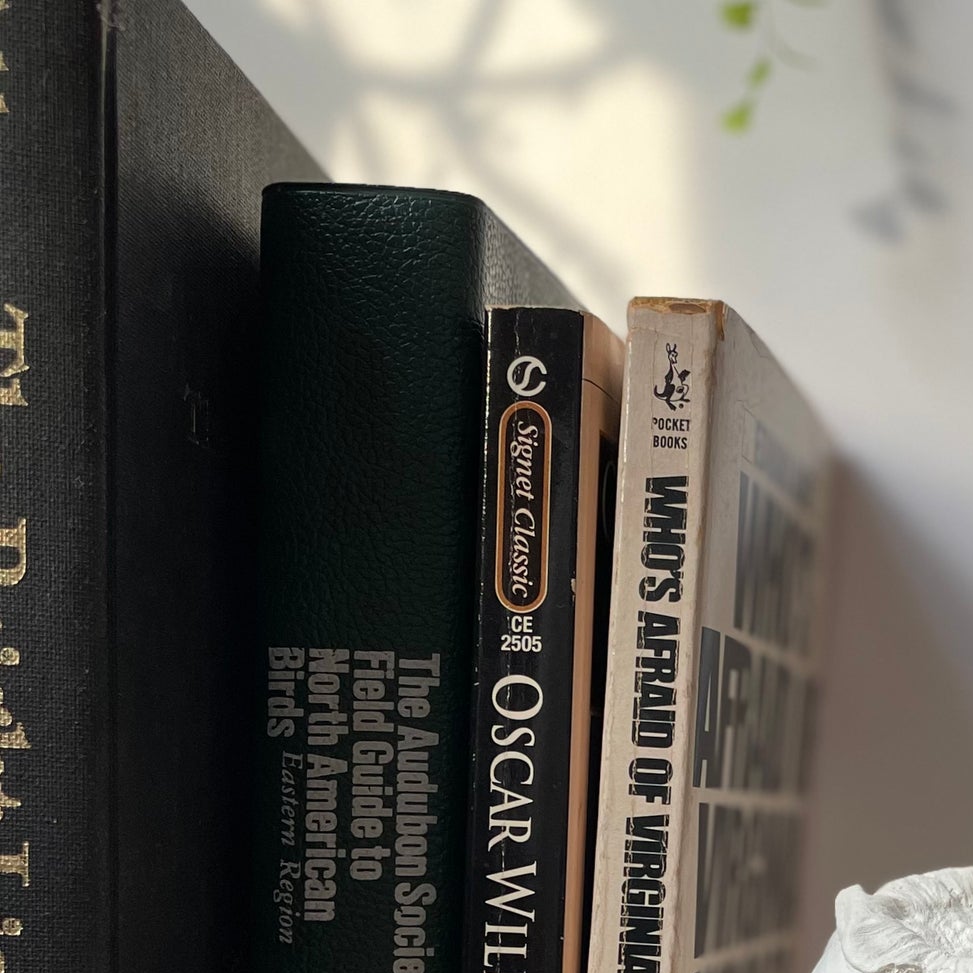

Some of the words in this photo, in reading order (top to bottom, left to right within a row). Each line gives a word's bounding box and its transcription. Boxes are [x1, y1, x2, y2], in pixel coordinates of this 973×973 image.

[510, 421, 538, 500] Signet
[652, 417, 690, 431] POCKET
[653, 437, 688, 449] BOOKS
[512, 508, 536, 598] Classic
[638, 476, 689, 602] WHO'S
[501, 635, 542, 653] 2505
[511, 615, 533, 633] CE
[267, 647, 305, 738] Birds
[307, 648, 350, 745] North
[352, 651, 395, 732] Field
[397, 653, 440, 718] The
[631, 610, 681, 748] AFRAID
[280, 750, 304, 846] Eastern
[350, 740, 395, 839] Guide
[394, 725, 440, 877] Audubon
[487, 674, 544, 852] OSCAR
[628, 757, 673, 805] OF
[304, 753, 349, 921] American
[350, 846, 391, 880] to
[273, 859, 301, 944] Region
